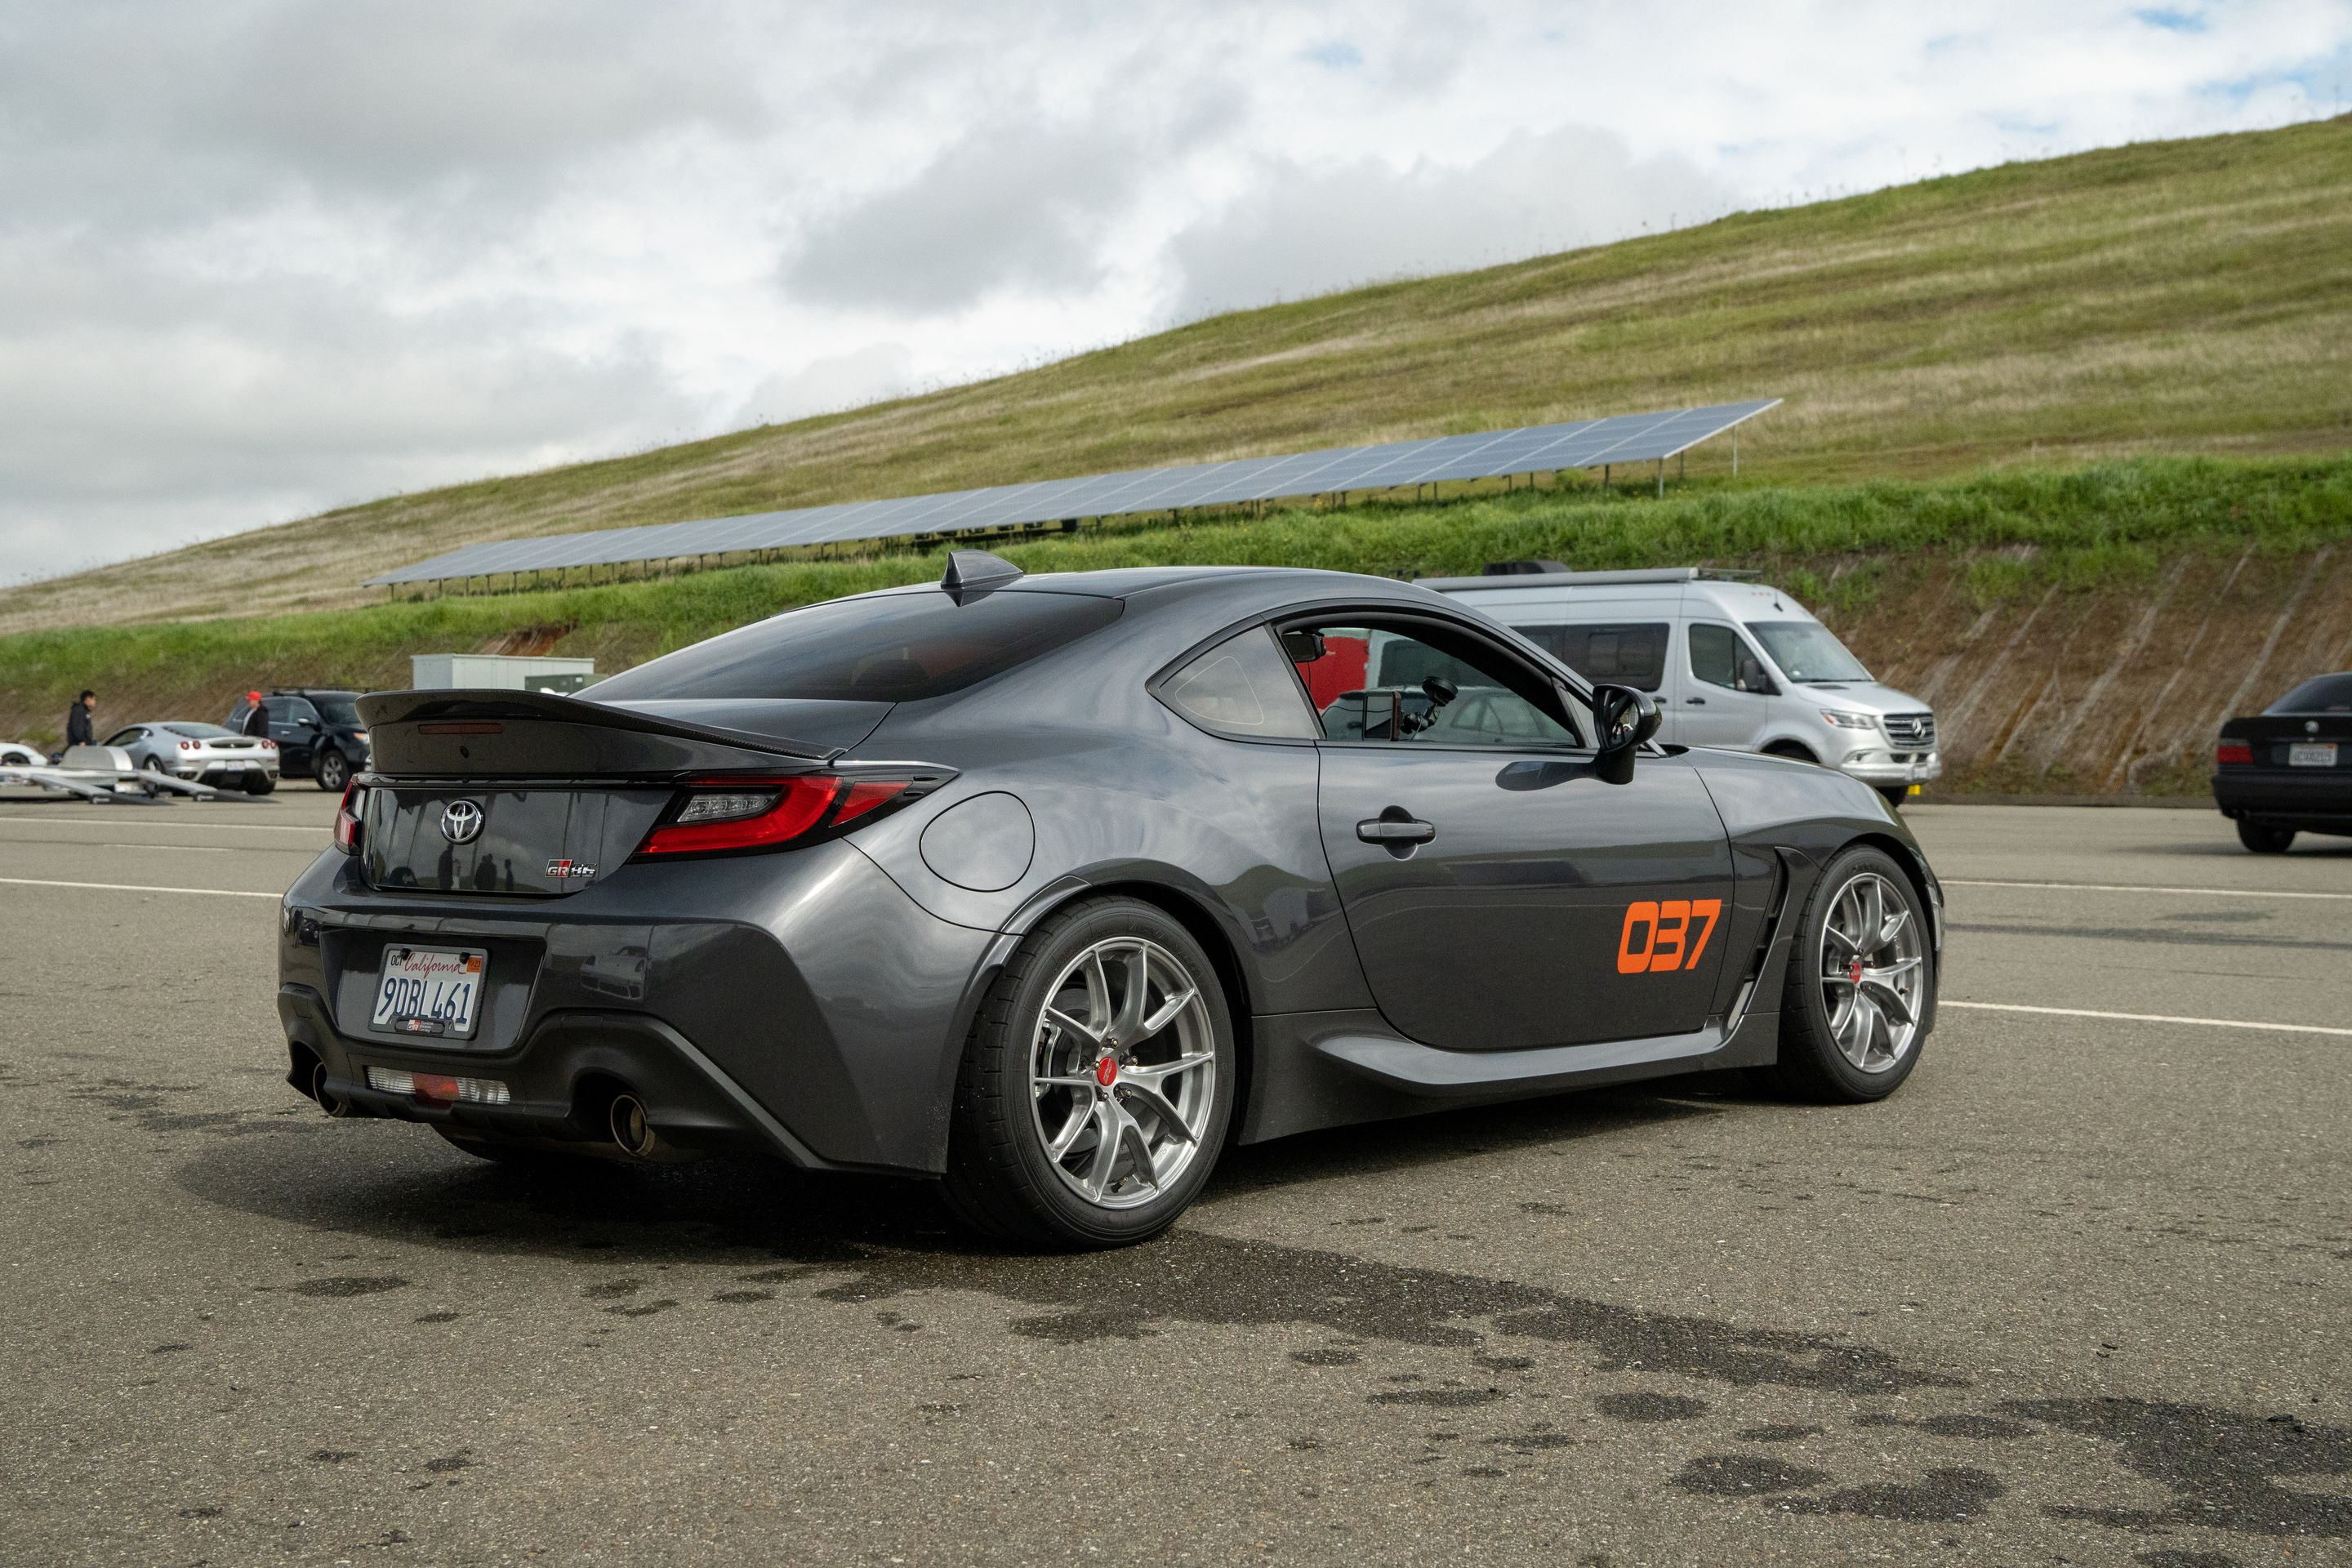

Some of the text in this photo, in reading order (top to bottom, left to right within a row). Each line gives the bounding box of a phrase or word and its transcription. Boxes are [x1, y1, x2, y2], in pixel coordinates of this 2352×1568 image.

[1617, 899, 1722, 974] 037
[390, 955, 403, 966] OCT
[404, 952, 466, 979] California
[378, 978, 471, 1024] 9DBL461
